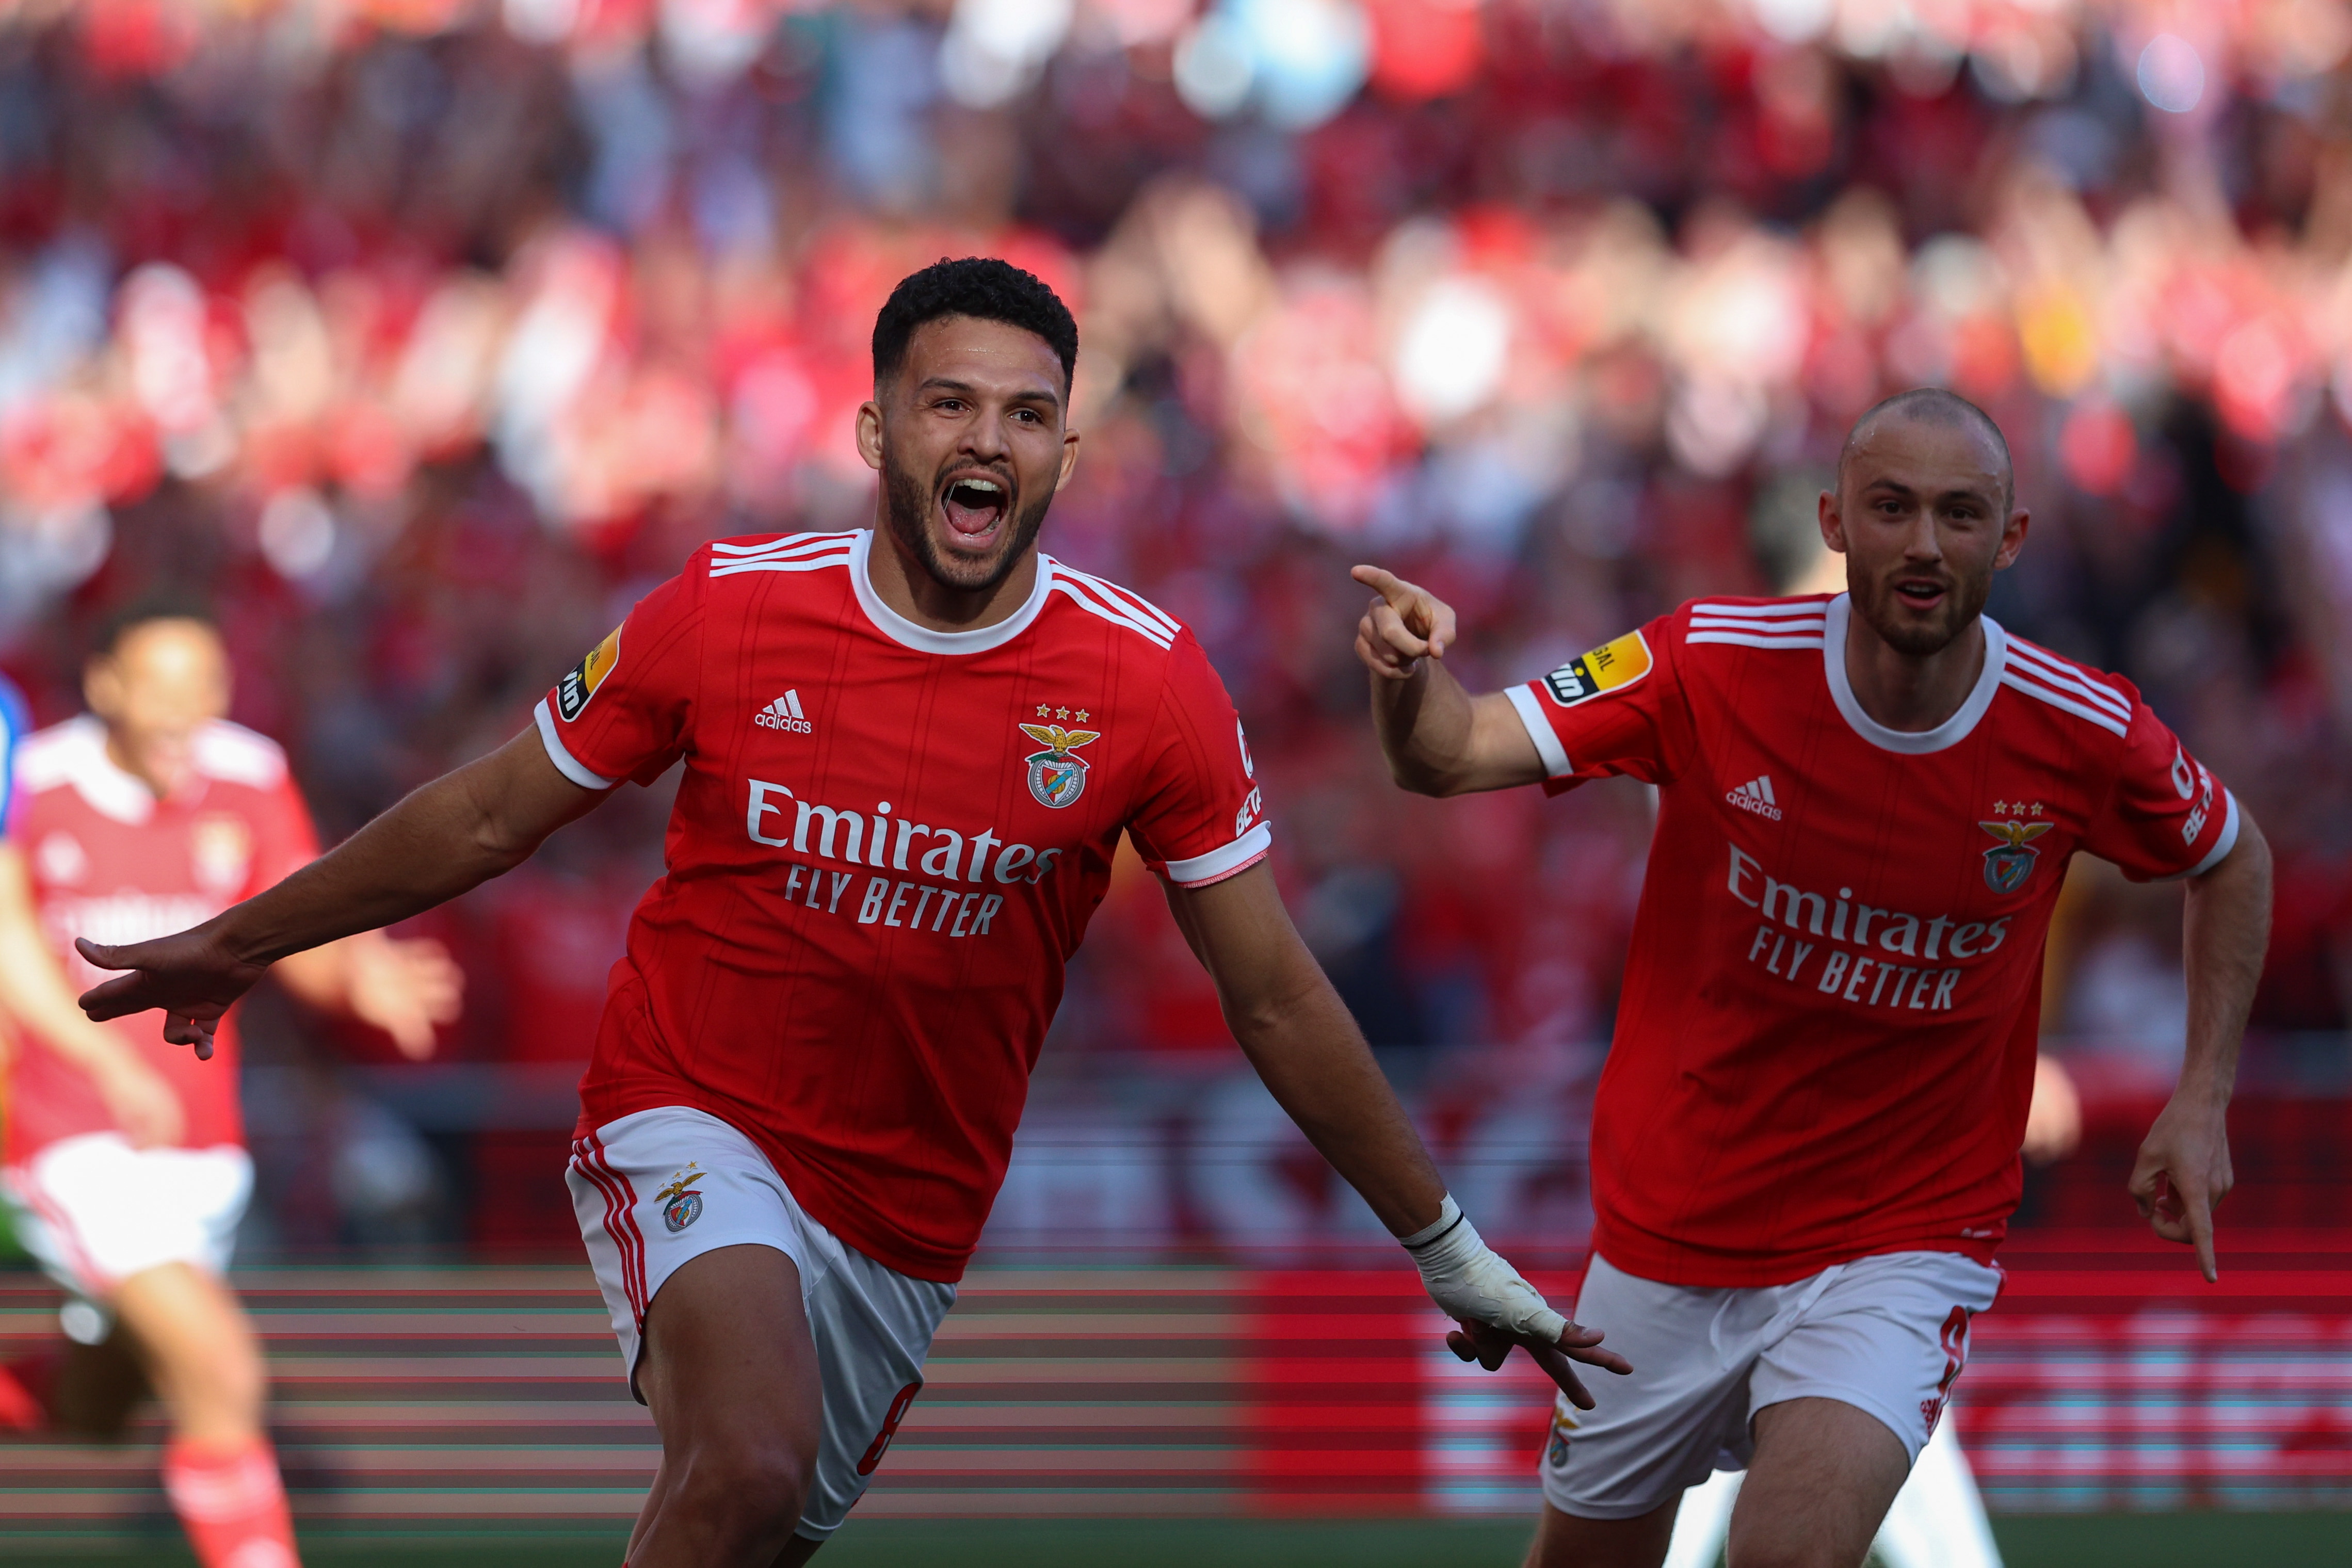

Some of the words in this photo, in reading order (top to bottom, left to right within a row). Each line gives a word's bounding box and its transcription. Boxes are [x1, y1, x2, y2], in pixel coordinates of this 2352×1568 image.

[755, 713, 811, 734] adidas
[747, 779, 1062, 884] Emirates
[1726, 791, 1782, 821] adidas
[785, 864, 853, 914] FLY
[858, 877, 1003, 937] BETTER
[1728, 842, 2011, 960] Emirates
[1748, 926, 1813, 980] FLY
[1818, 950, 1961, 1010] BETTER
